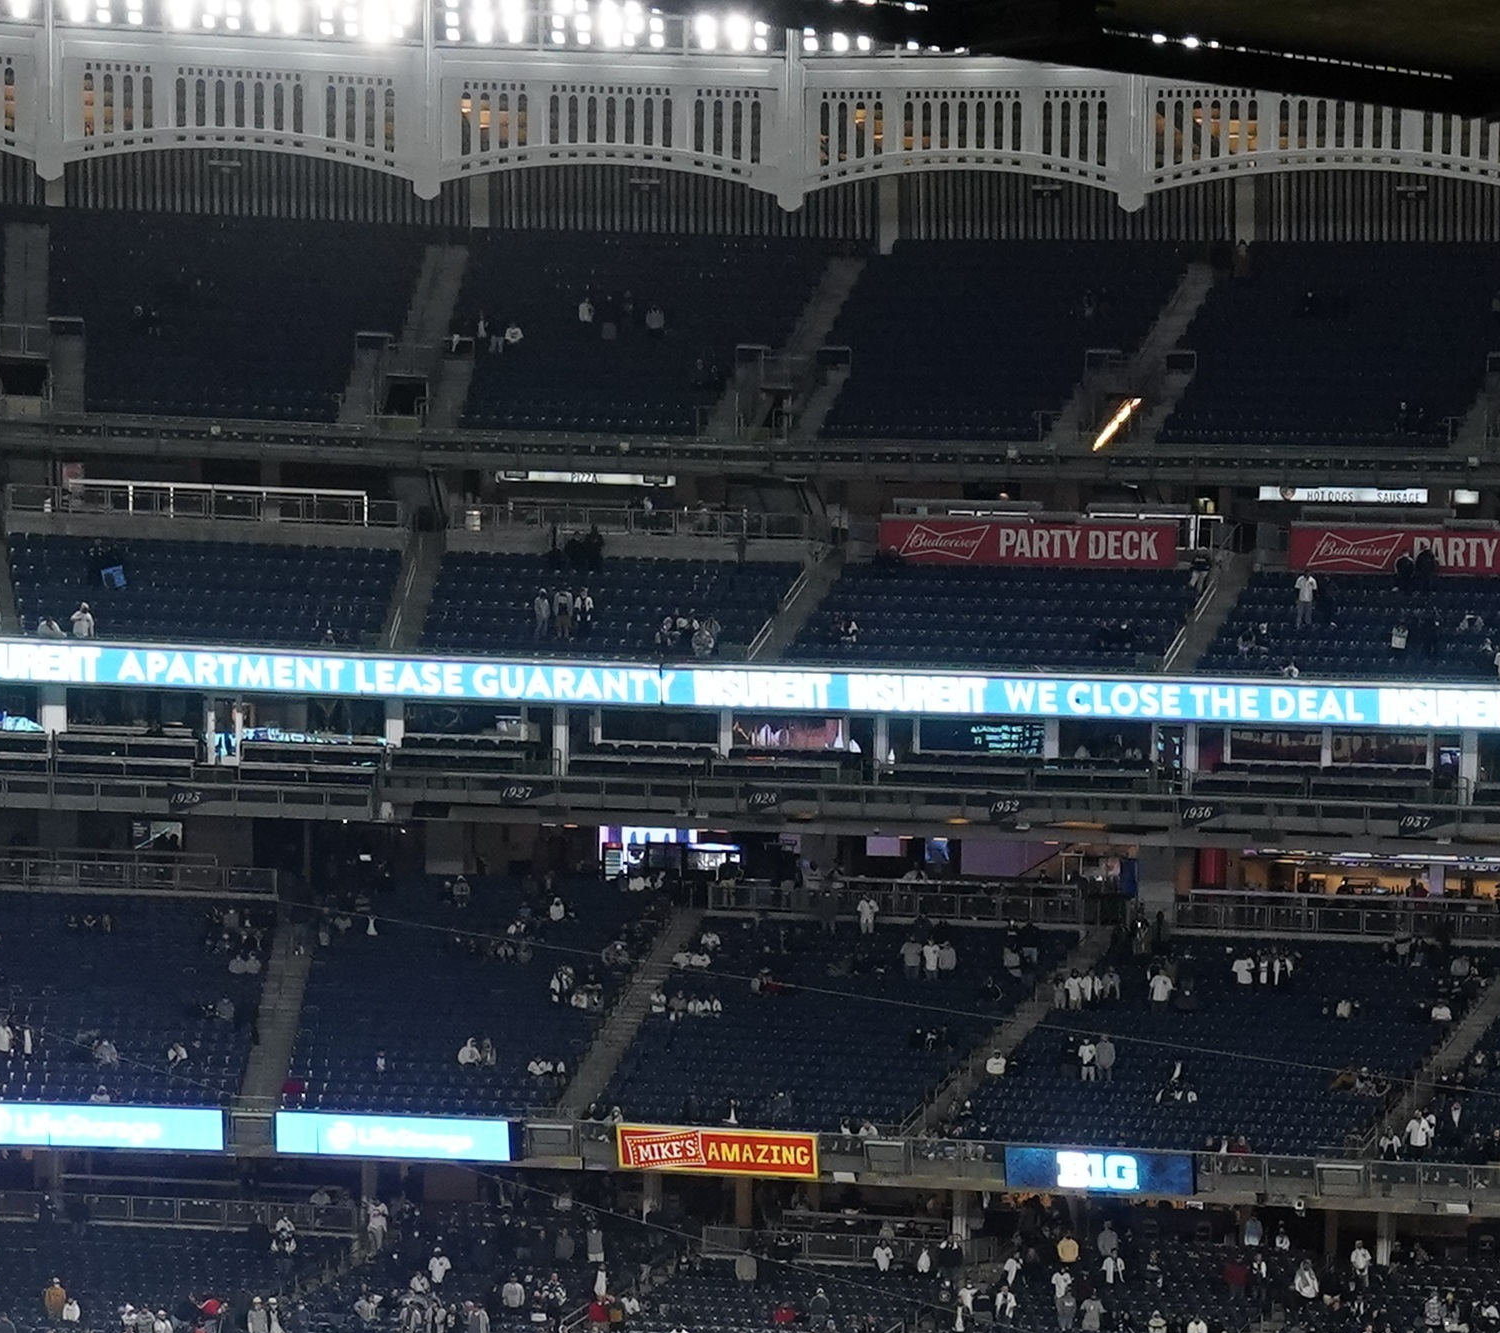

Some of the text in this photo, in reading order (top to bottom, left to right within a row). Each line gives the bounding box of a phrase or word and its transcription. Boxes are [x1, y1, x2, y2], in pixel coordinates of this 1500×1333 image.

[1306, 491, 1355, 503] HOT DOGS
[909, 531, 978, 549] Budweiser
[999, 528, 1159, 561] PARTY DECK
[1319, 541, 1391, 558] Budweiser
[117, 650, 676, 701] APARTMENT LEASE GUARANTY
[1003, 681, 1364, 722] WE CLOSE THE DEAL
[637, 1141, 811, 1166] MIKE'S AMAZING
